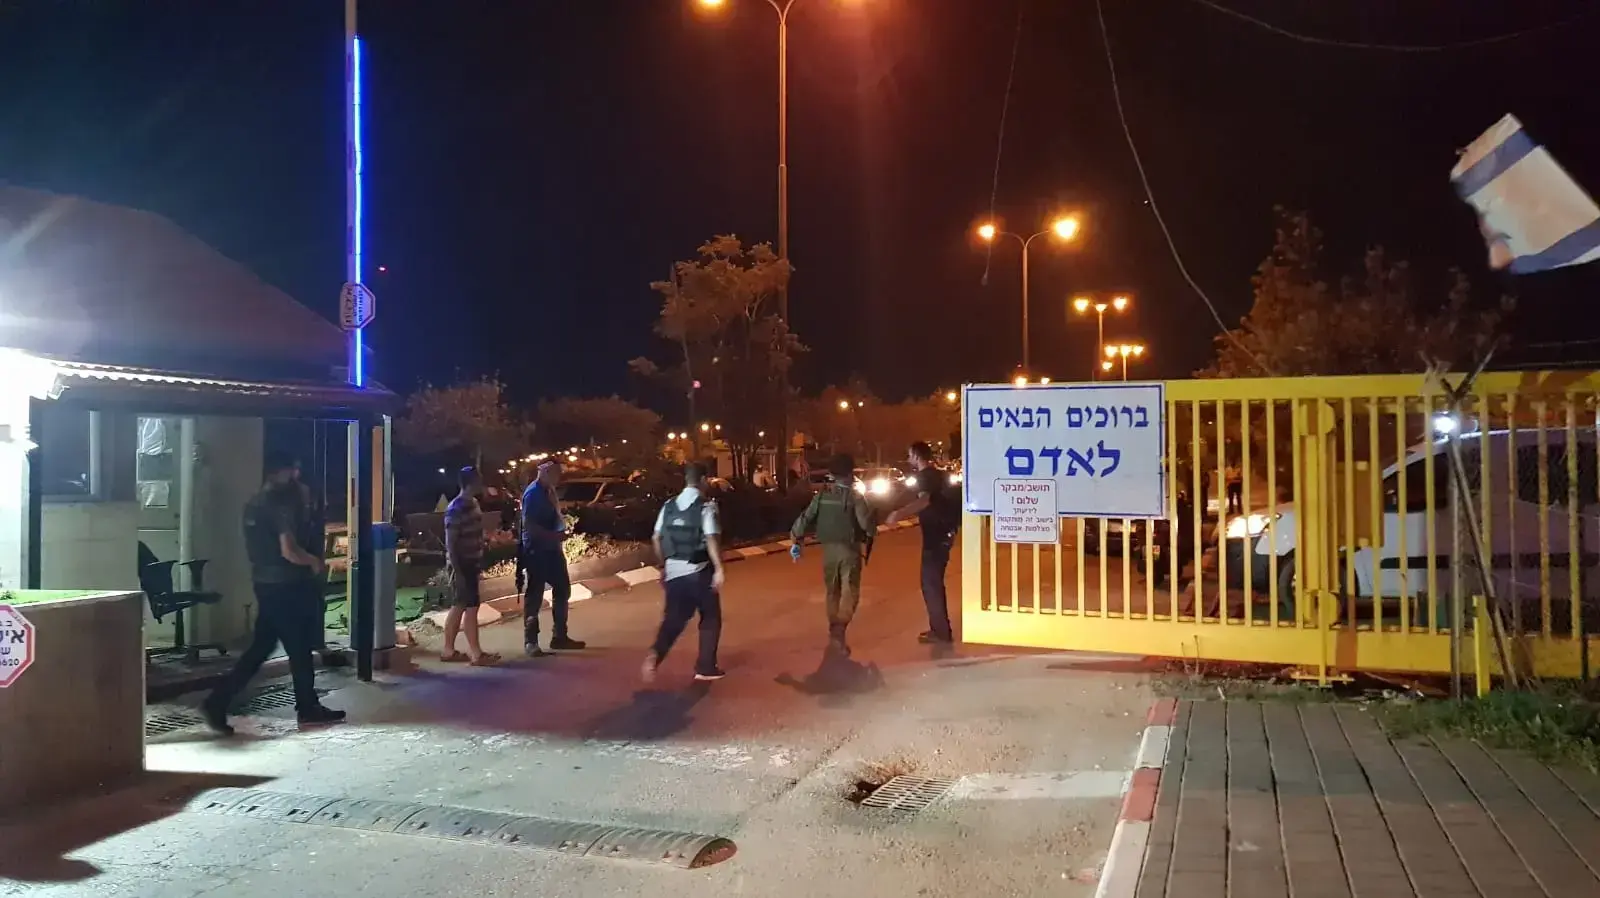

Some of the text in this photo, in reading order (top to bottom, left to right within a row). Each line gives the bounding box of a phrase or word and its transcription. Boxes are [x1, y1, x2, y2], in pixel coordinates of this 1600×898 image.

[978, 404, 1149, 428] ברוכים הבאים
[1004, 439, 1120, 478] לאדם
[1000, 484, 1050, 493] תושב/מבקר
[1016, 496, 1039, 505] שלום
